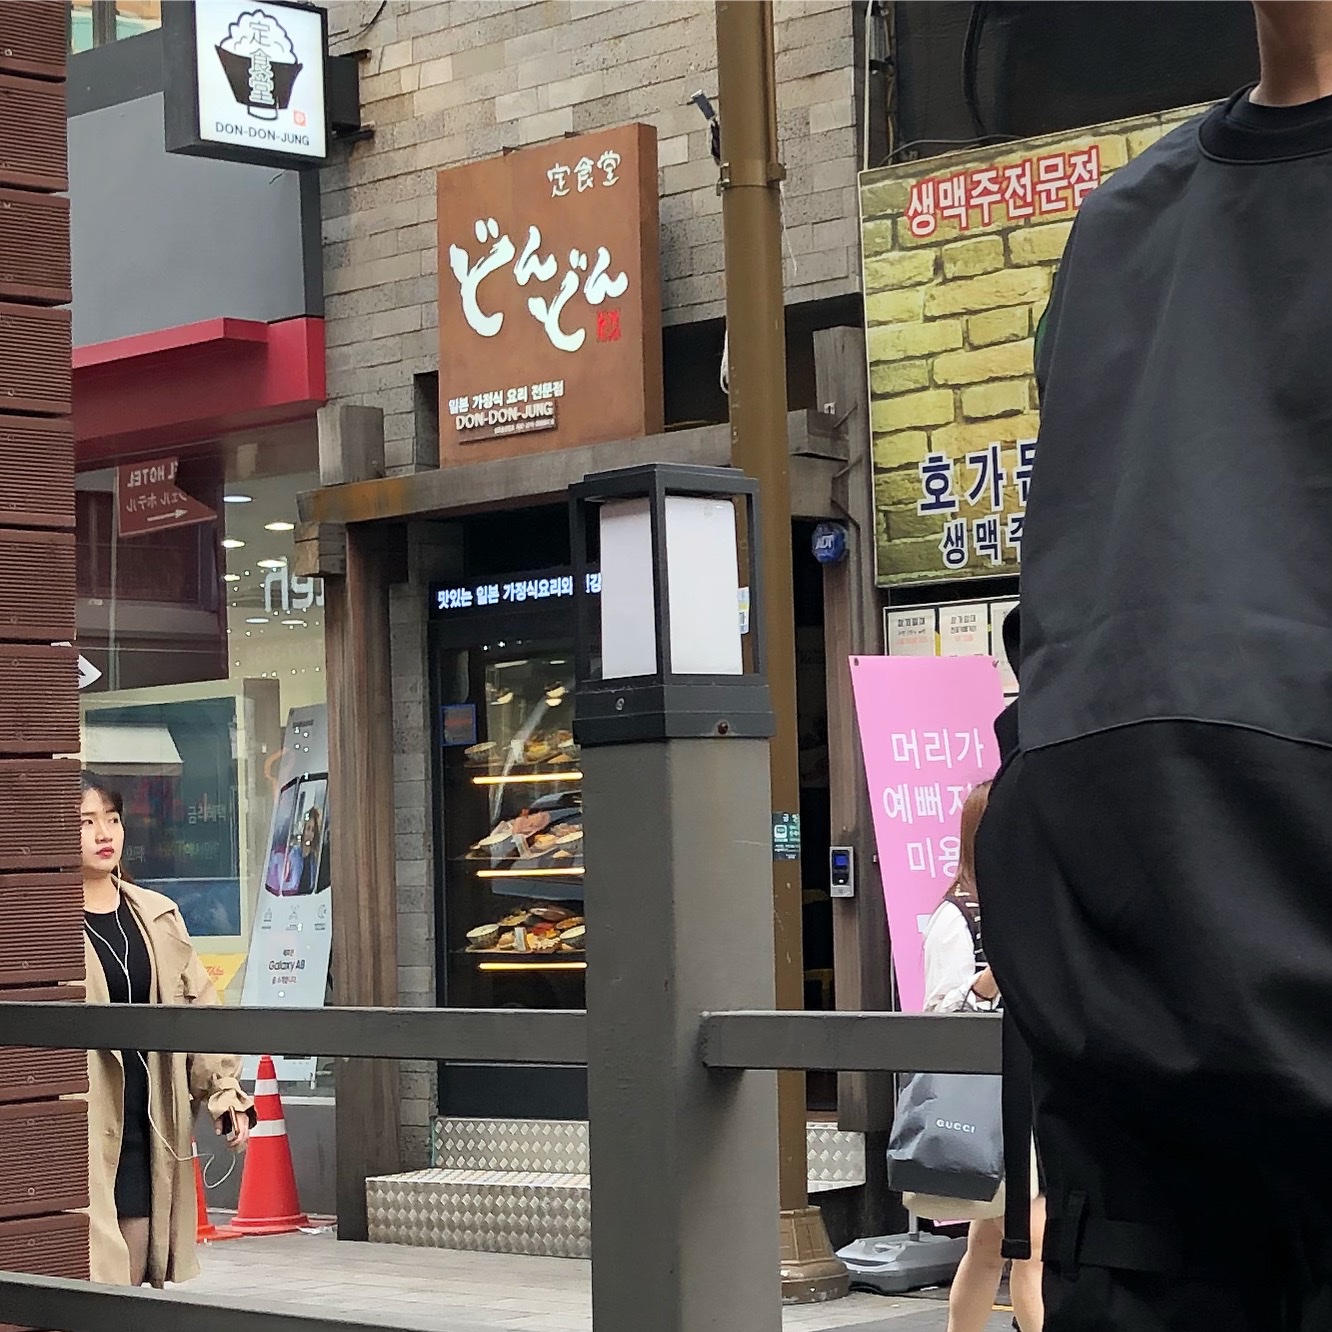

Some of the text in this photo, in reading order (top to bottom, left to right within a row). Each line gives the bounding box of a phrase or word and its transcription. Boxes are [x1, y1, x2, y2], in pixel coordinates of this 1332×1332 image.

[248, 20, 275, 105] 定食堂
[215, 121, 310, 146] DON-DON-JUNG
[546, 150, 621, 198] 定食堂
[907, 147, 1099, 237] 생맥주전문점
[472, 390, 503, 410] 가정식
[506, 386, 528, 405] 요리
[531, 380, 564, 401] 전문점
[456, 401, 554, 431] DON-DON-JUNG
[438, 587, 473, 609] 맛있는
[476, 584, 499, 605] 일본
[891, 727, 984, 769] 머리가
[936, 1119, 975, 1134] GUCCI
